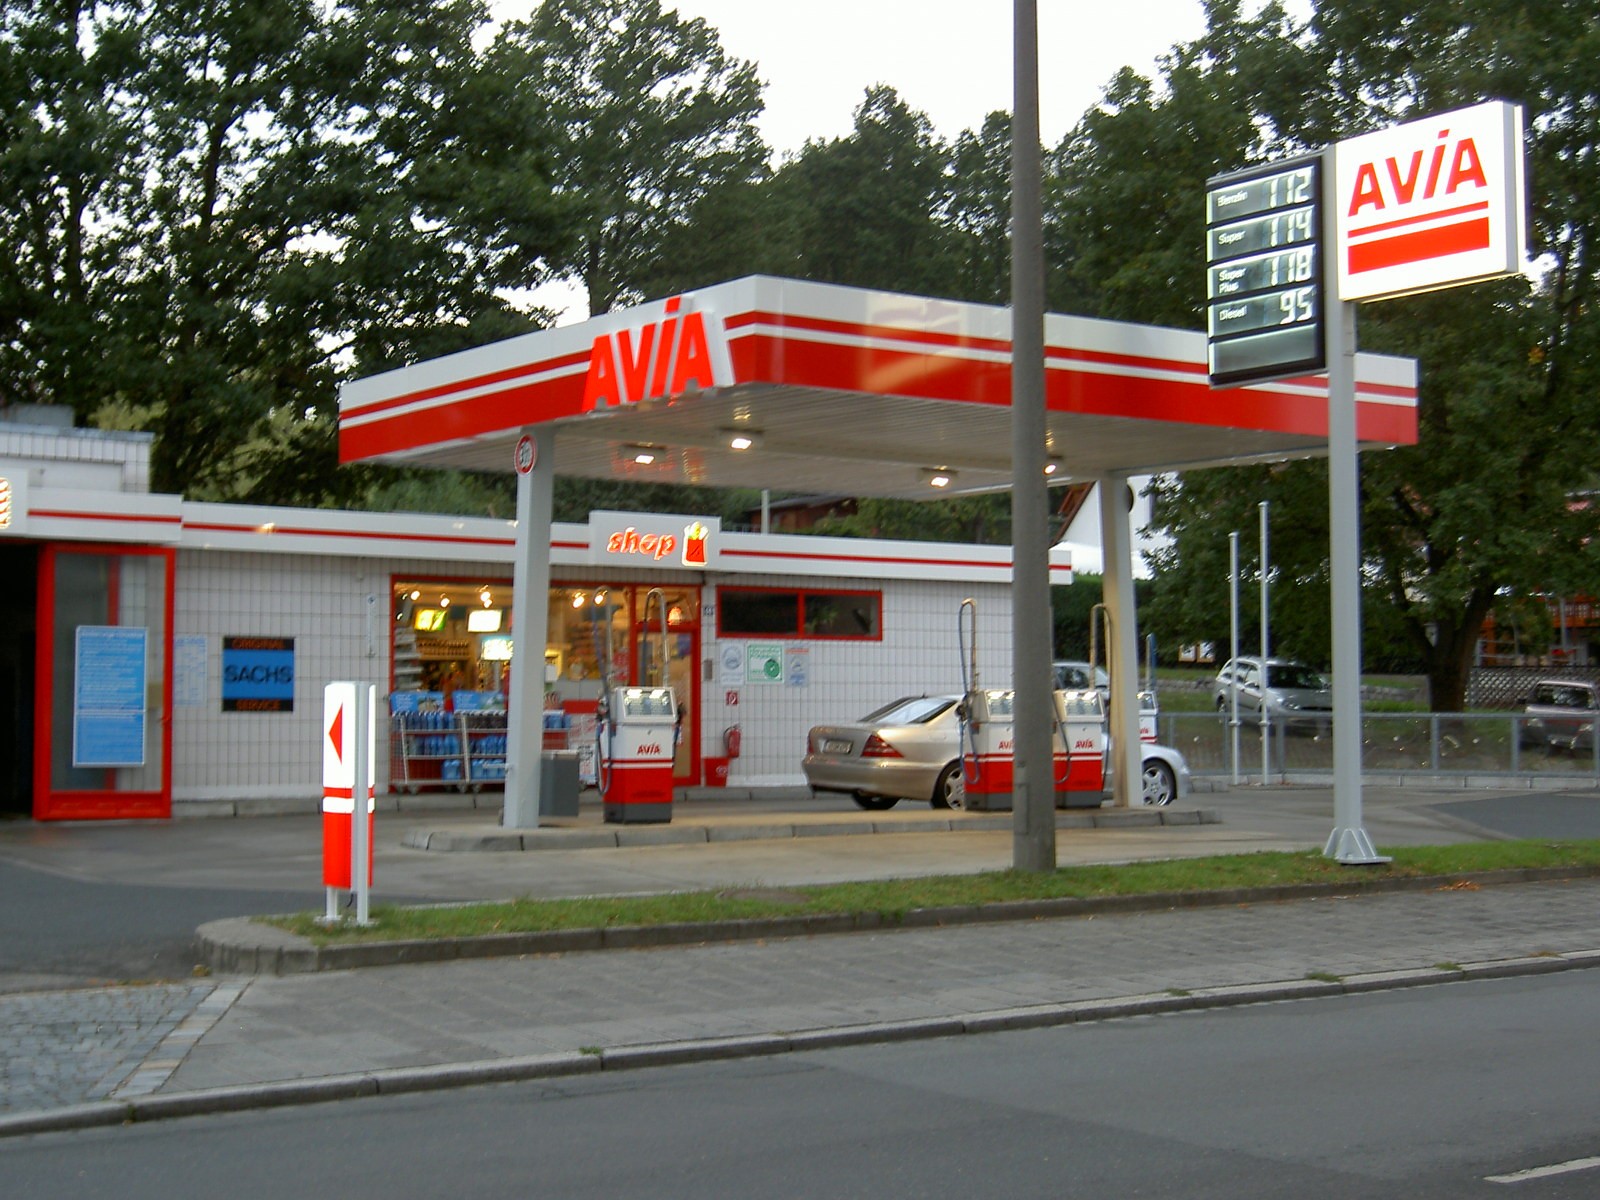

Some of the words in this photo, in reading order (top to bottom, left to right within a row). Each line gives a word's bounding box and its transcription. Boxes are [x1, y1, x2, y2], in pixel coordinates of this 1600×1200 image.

[1217, 190, 1248, 207] Benzin
[1270, 173, 1311, 208] 112
[1348, 129, 1487, 217] AVIA
[1218, 230, 1246, 246] Super
[1271, 212, 1312, 247] 114
[1218, 267, 1247, 282] Super
[1271, 249, 1312, 287] 118
[1219, 281, 1240, 295] Plus
[1219, 305, 1248, 321] Diesel
[1279, 287, 1313, 325] 95
[581, 296, 714, 412] AVIA
[606, 526, 677, 561] shop
[224, 664, 292, 685] SACHS
